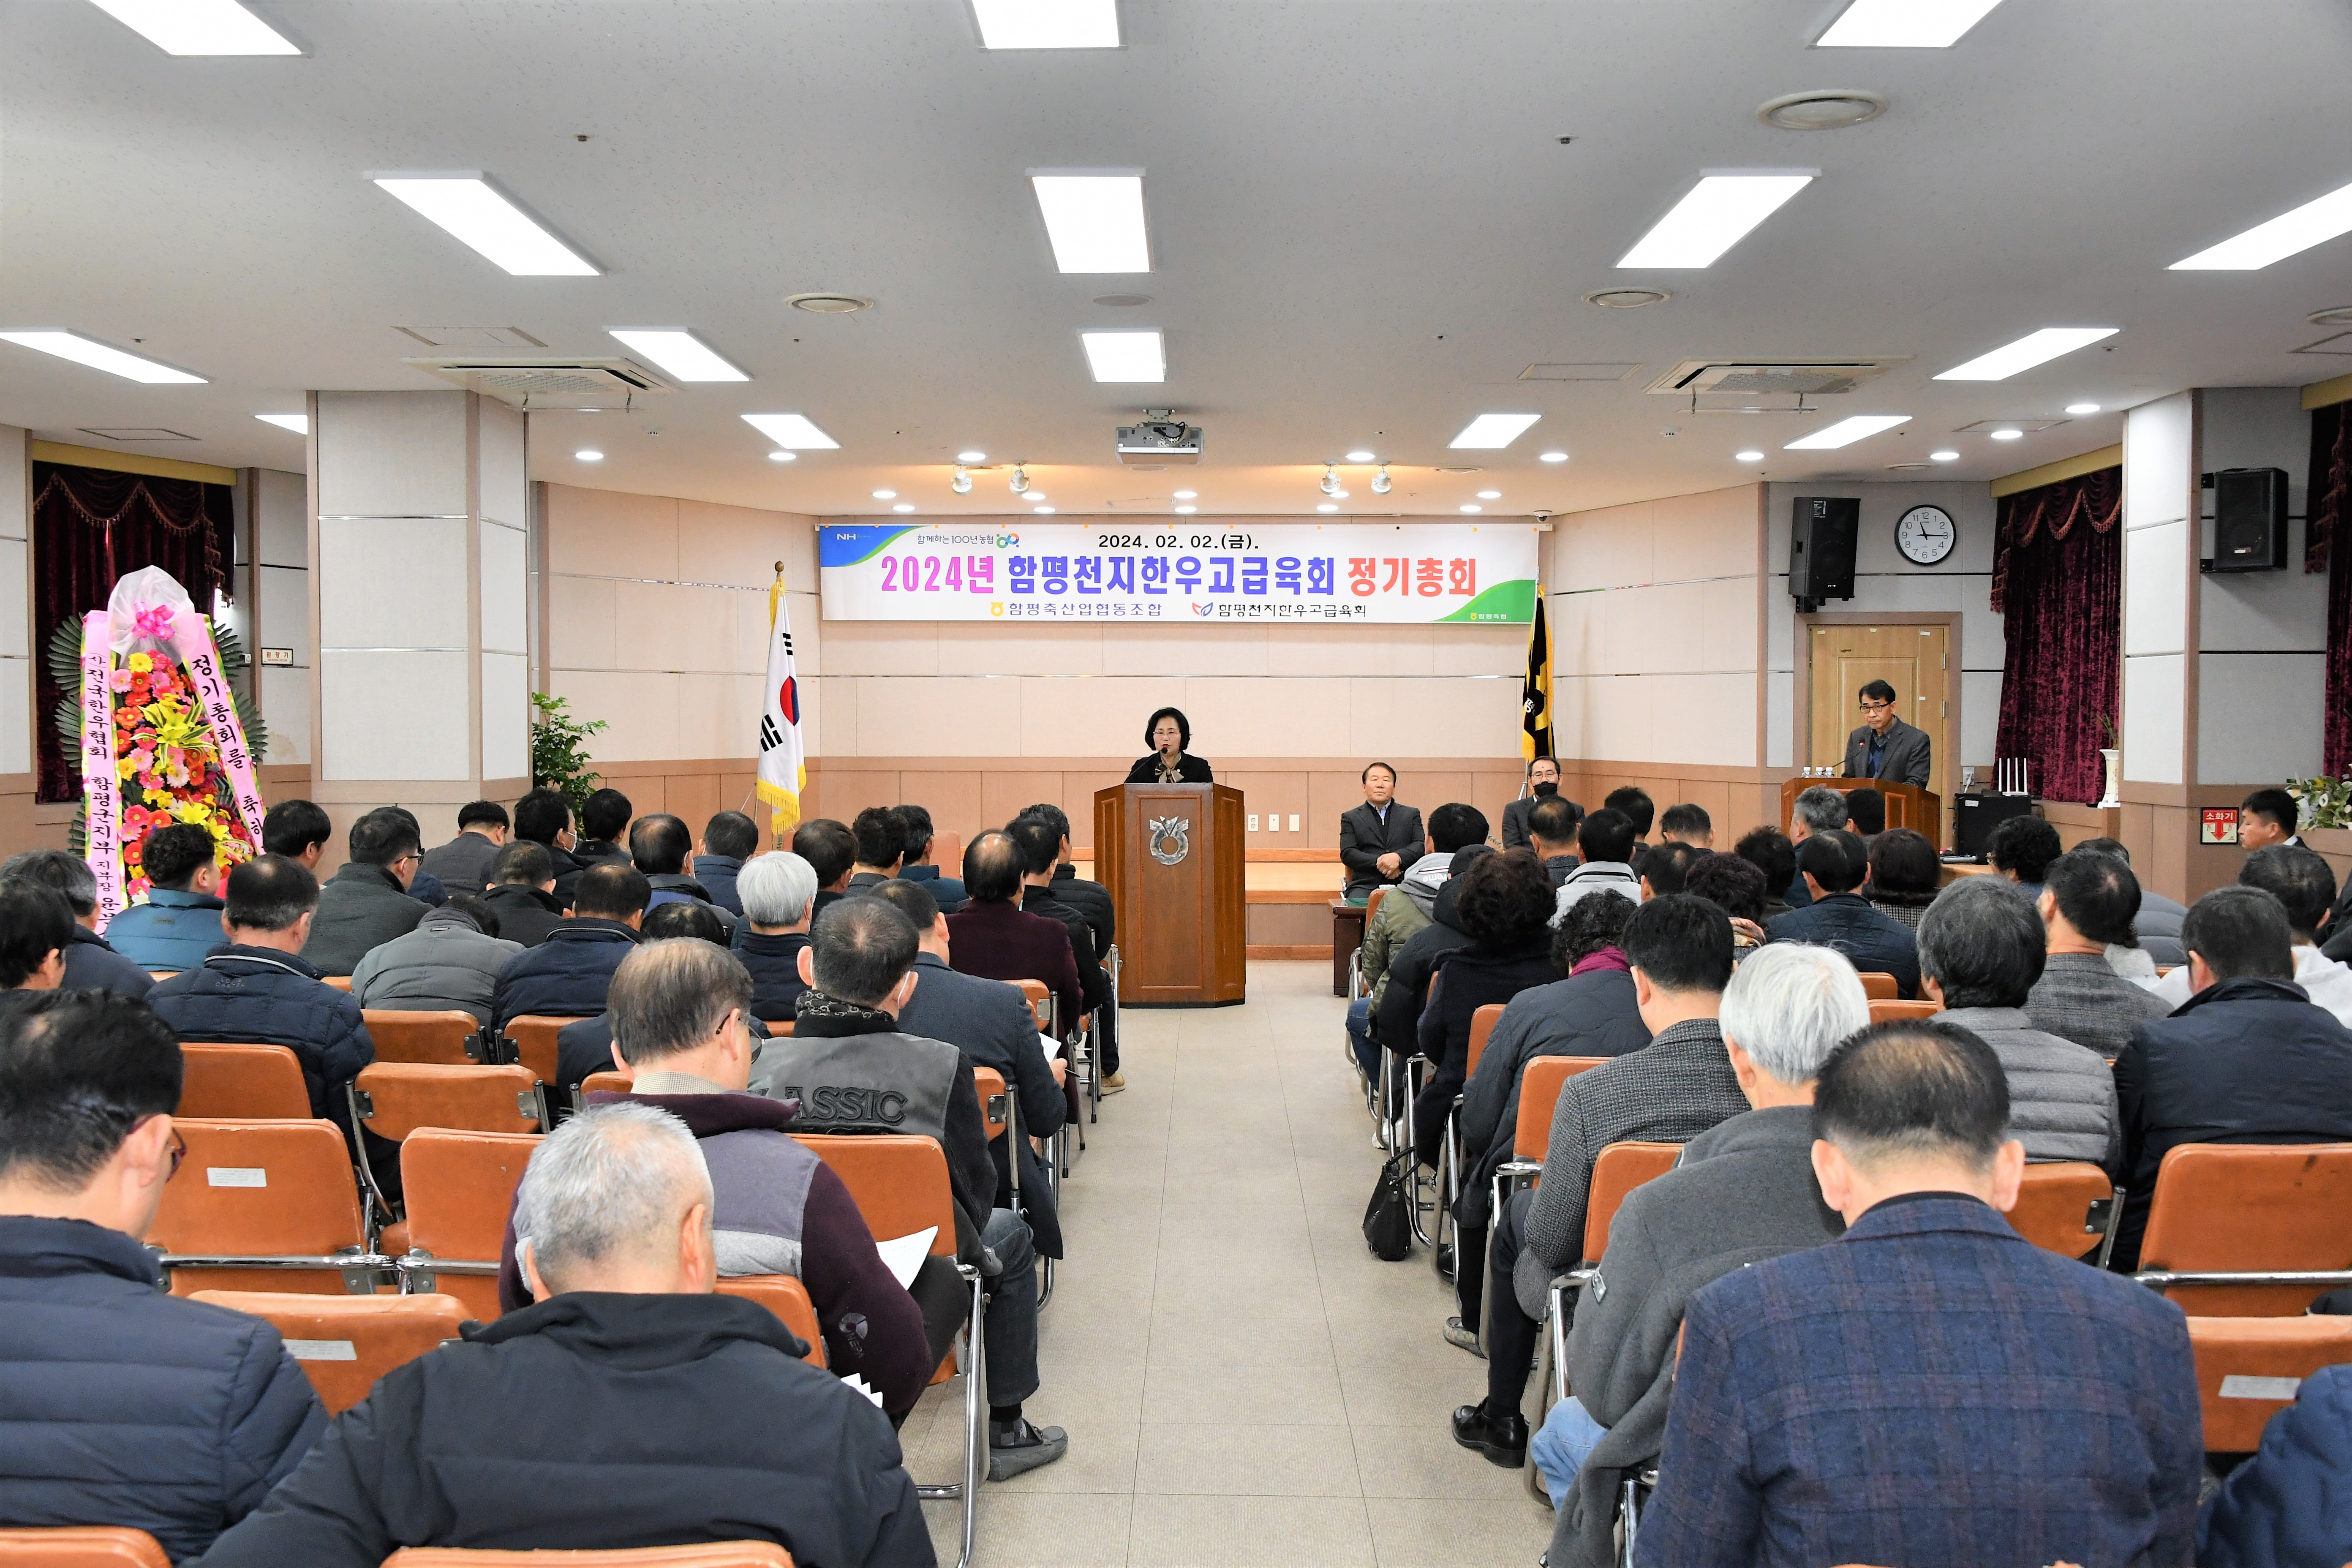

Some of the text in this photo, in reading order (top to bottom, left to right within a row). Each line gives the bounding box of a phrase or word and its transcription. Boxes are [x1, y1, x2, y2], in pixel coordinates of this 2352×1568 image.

[917, 534, 994, 544] 함께하는 100년 농협
[1098, 535, 1148, 548] 2024.
[1156, 535, 1183, 548] 02.
[881, 555, 1476, 597] 2024년 함평천지한우고급육회 정기총회
[1009, 603, 1162, 616] 함평축산업협동조합
[1219, 604, 1366, 618] 함평천지한우고급육회
[192, 655, 245, 769] 정기총회를
[91, 777, 115, 855] 함평군지부
[2205, 812, 2233, 821] 소화기
[96, 861, 114, 892] 지부장
[760, 1086, 909, 1126] ASSIC
